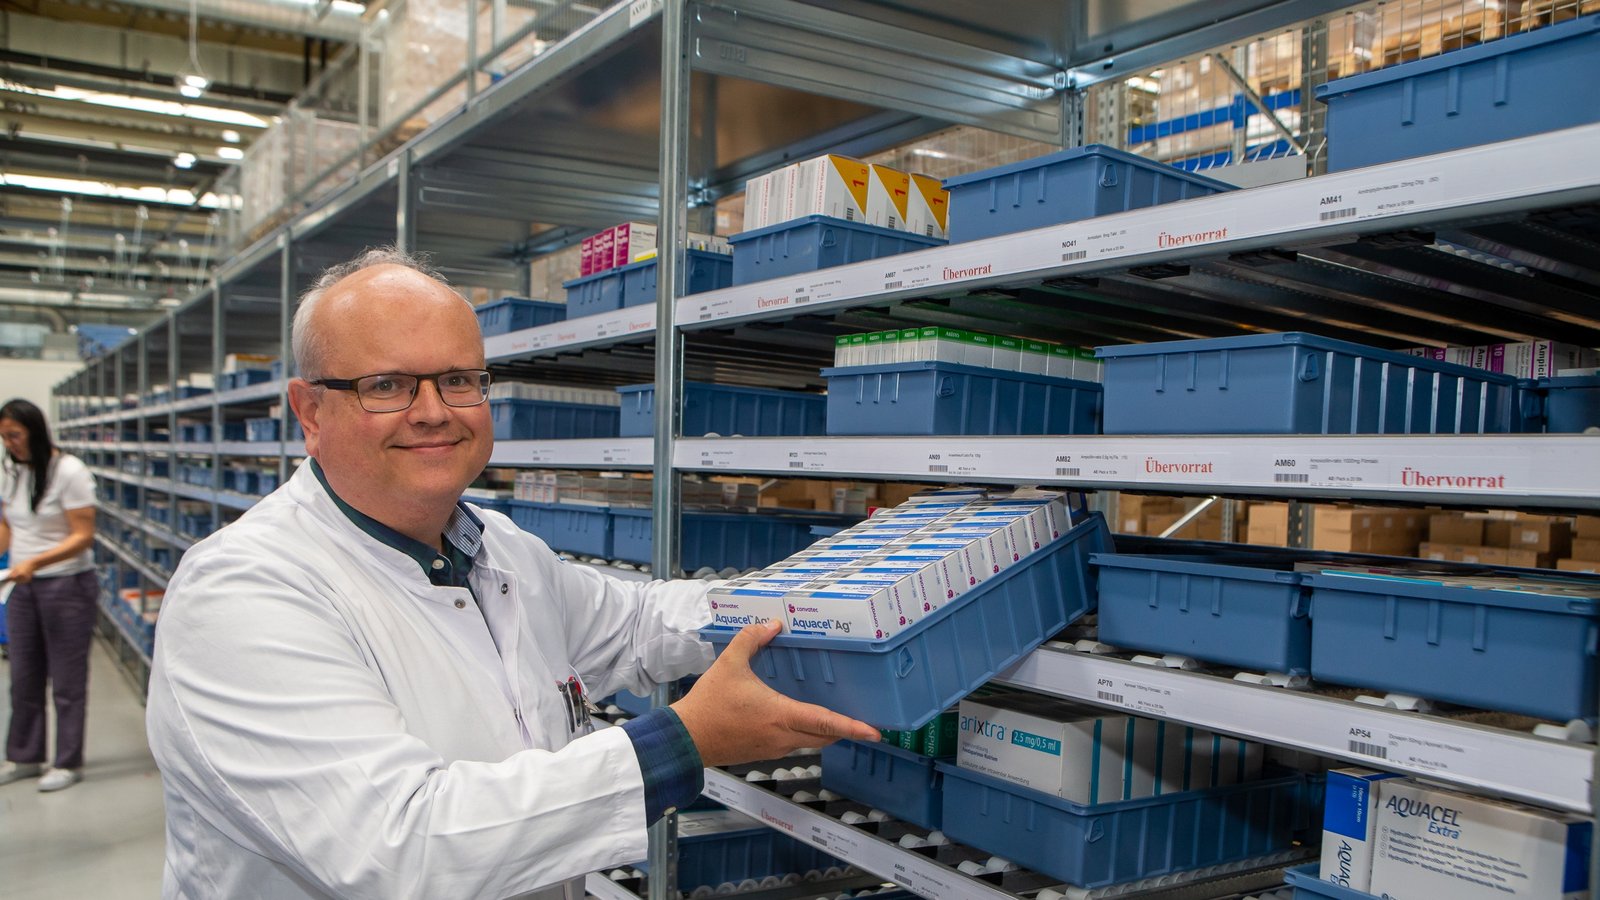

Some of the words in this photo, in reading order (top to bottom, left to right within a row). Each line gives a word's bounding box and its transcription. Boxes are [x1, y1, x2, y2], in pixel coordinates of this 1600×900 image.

[1320, 195, 1342, 206] AM41
[1158, 227, 1228, 249] Übervorrat
[943, 263, 992, 281] Übervorrat
[1055, 455, 1071, 463] AM82
[1145, 456, 1213, 473] Übervorrat
[1274, 458, 1296, 467] AM60
[1401, 467, 1506, 489] Übervorrat
[919, 572, 927, 601] convatec
[893, 585, 903, 615] convatec
[869, 598, 879, 628] convatec
[1097, 678, 1113, 688] AP70
[960, 716, 1005, 741] arixtra
[1349, 727, 1371, 739] AP54
[1014, 731, 1024, 743] 2,5
[1025, 734, 1047, 749] mg/0,5
[1047, 741, 1056, 751] ml
